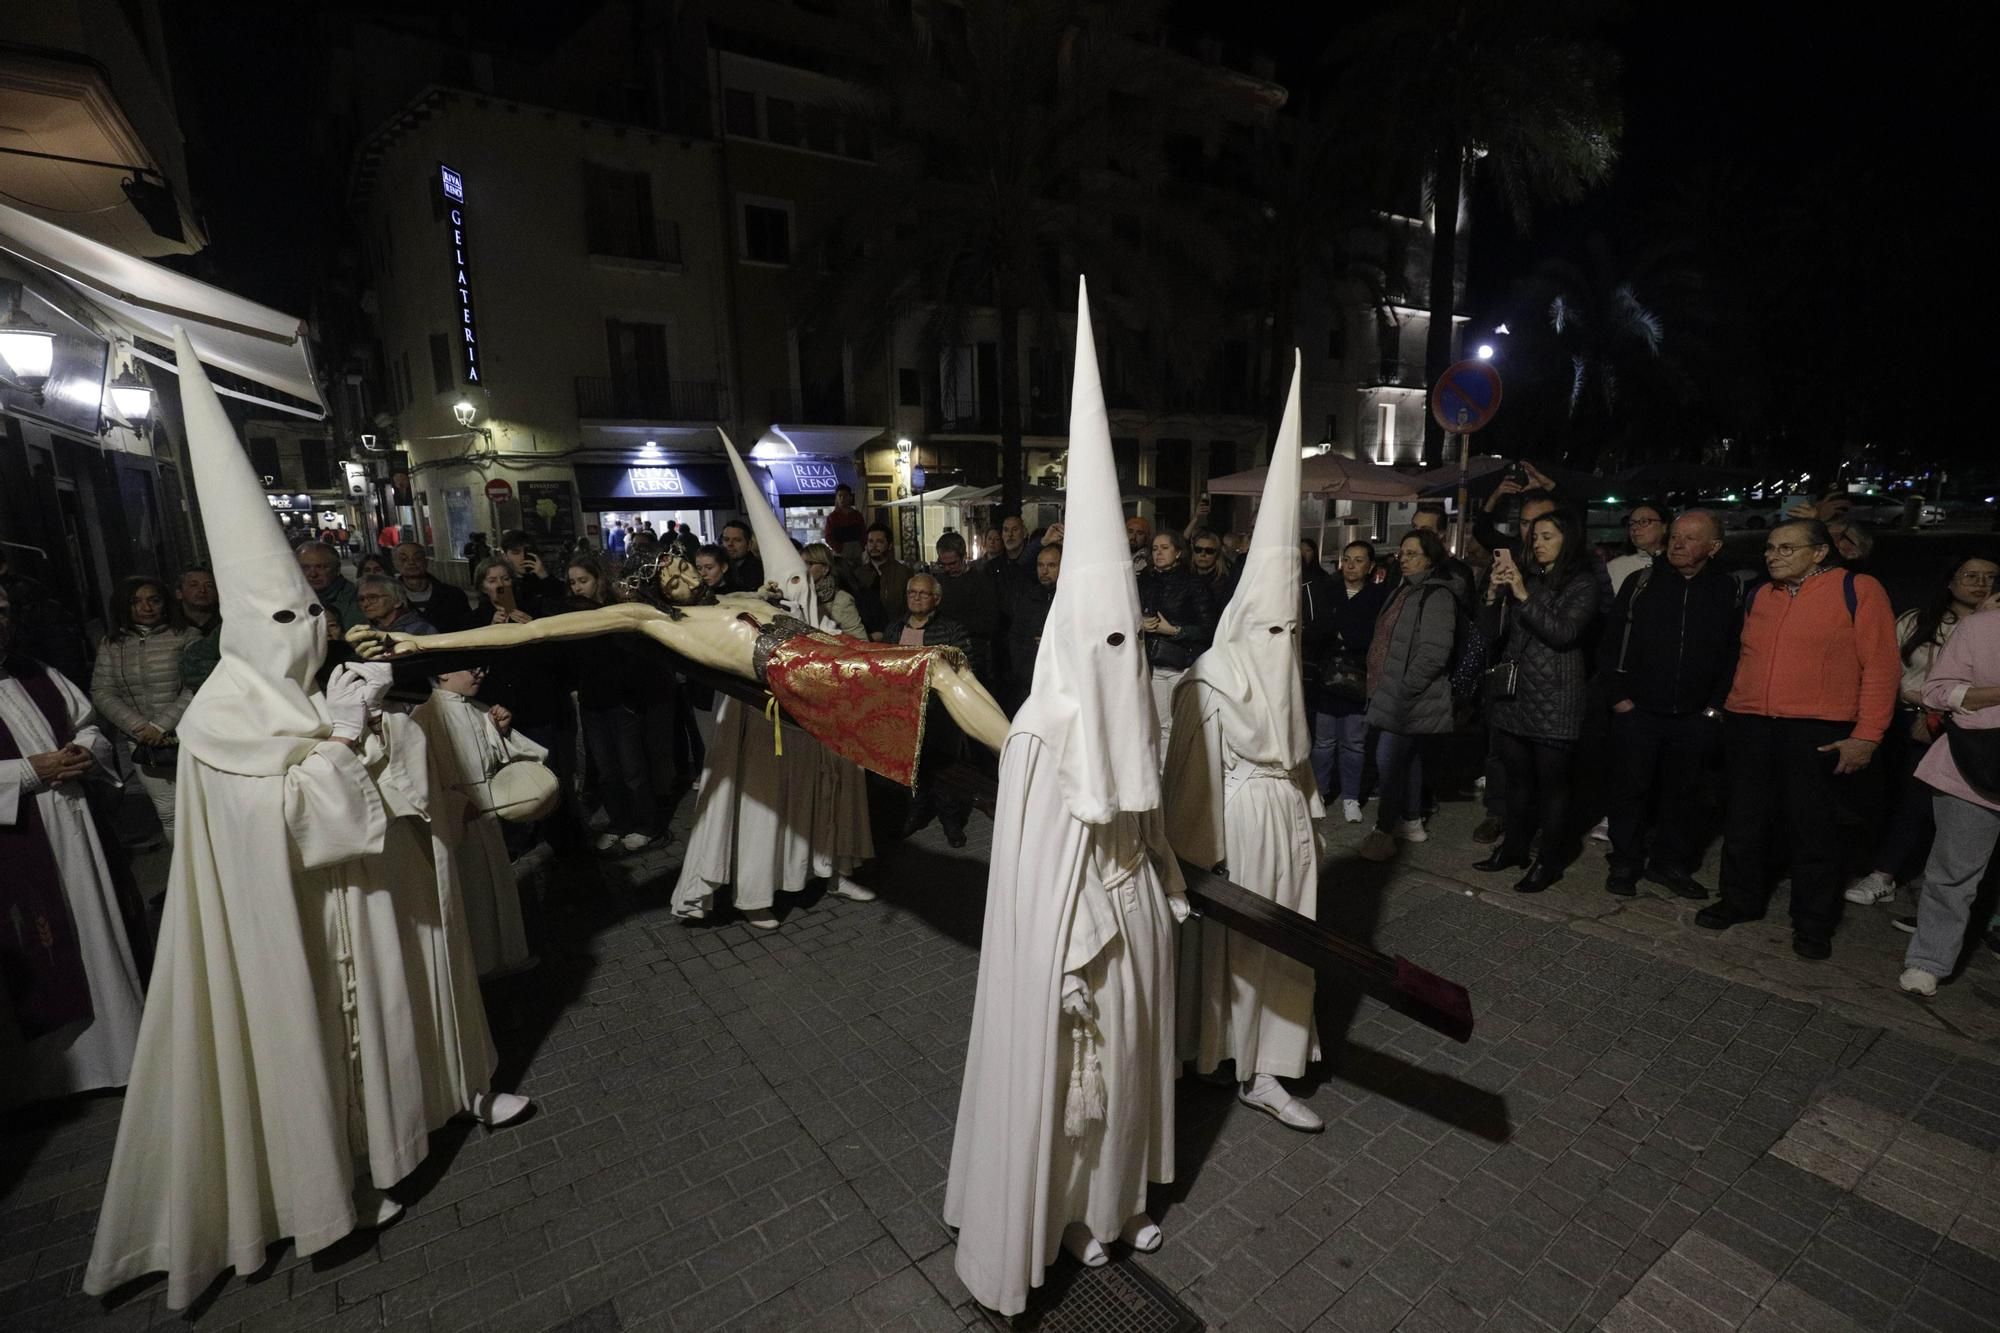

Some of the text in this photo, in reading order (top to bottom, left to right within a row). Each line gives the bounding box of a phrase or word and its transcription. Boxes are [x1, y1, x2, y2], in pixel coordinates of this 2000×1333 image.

[443, 171, 460, 187] RIVA
[446, 183, 462, 198] RENO
[451, 210, 479, 381] GELATERIA
[796, 465, 832, 475] RIVA
[637, 481, 679, 492] RENO
[800, 478, 836, 488] RENO
